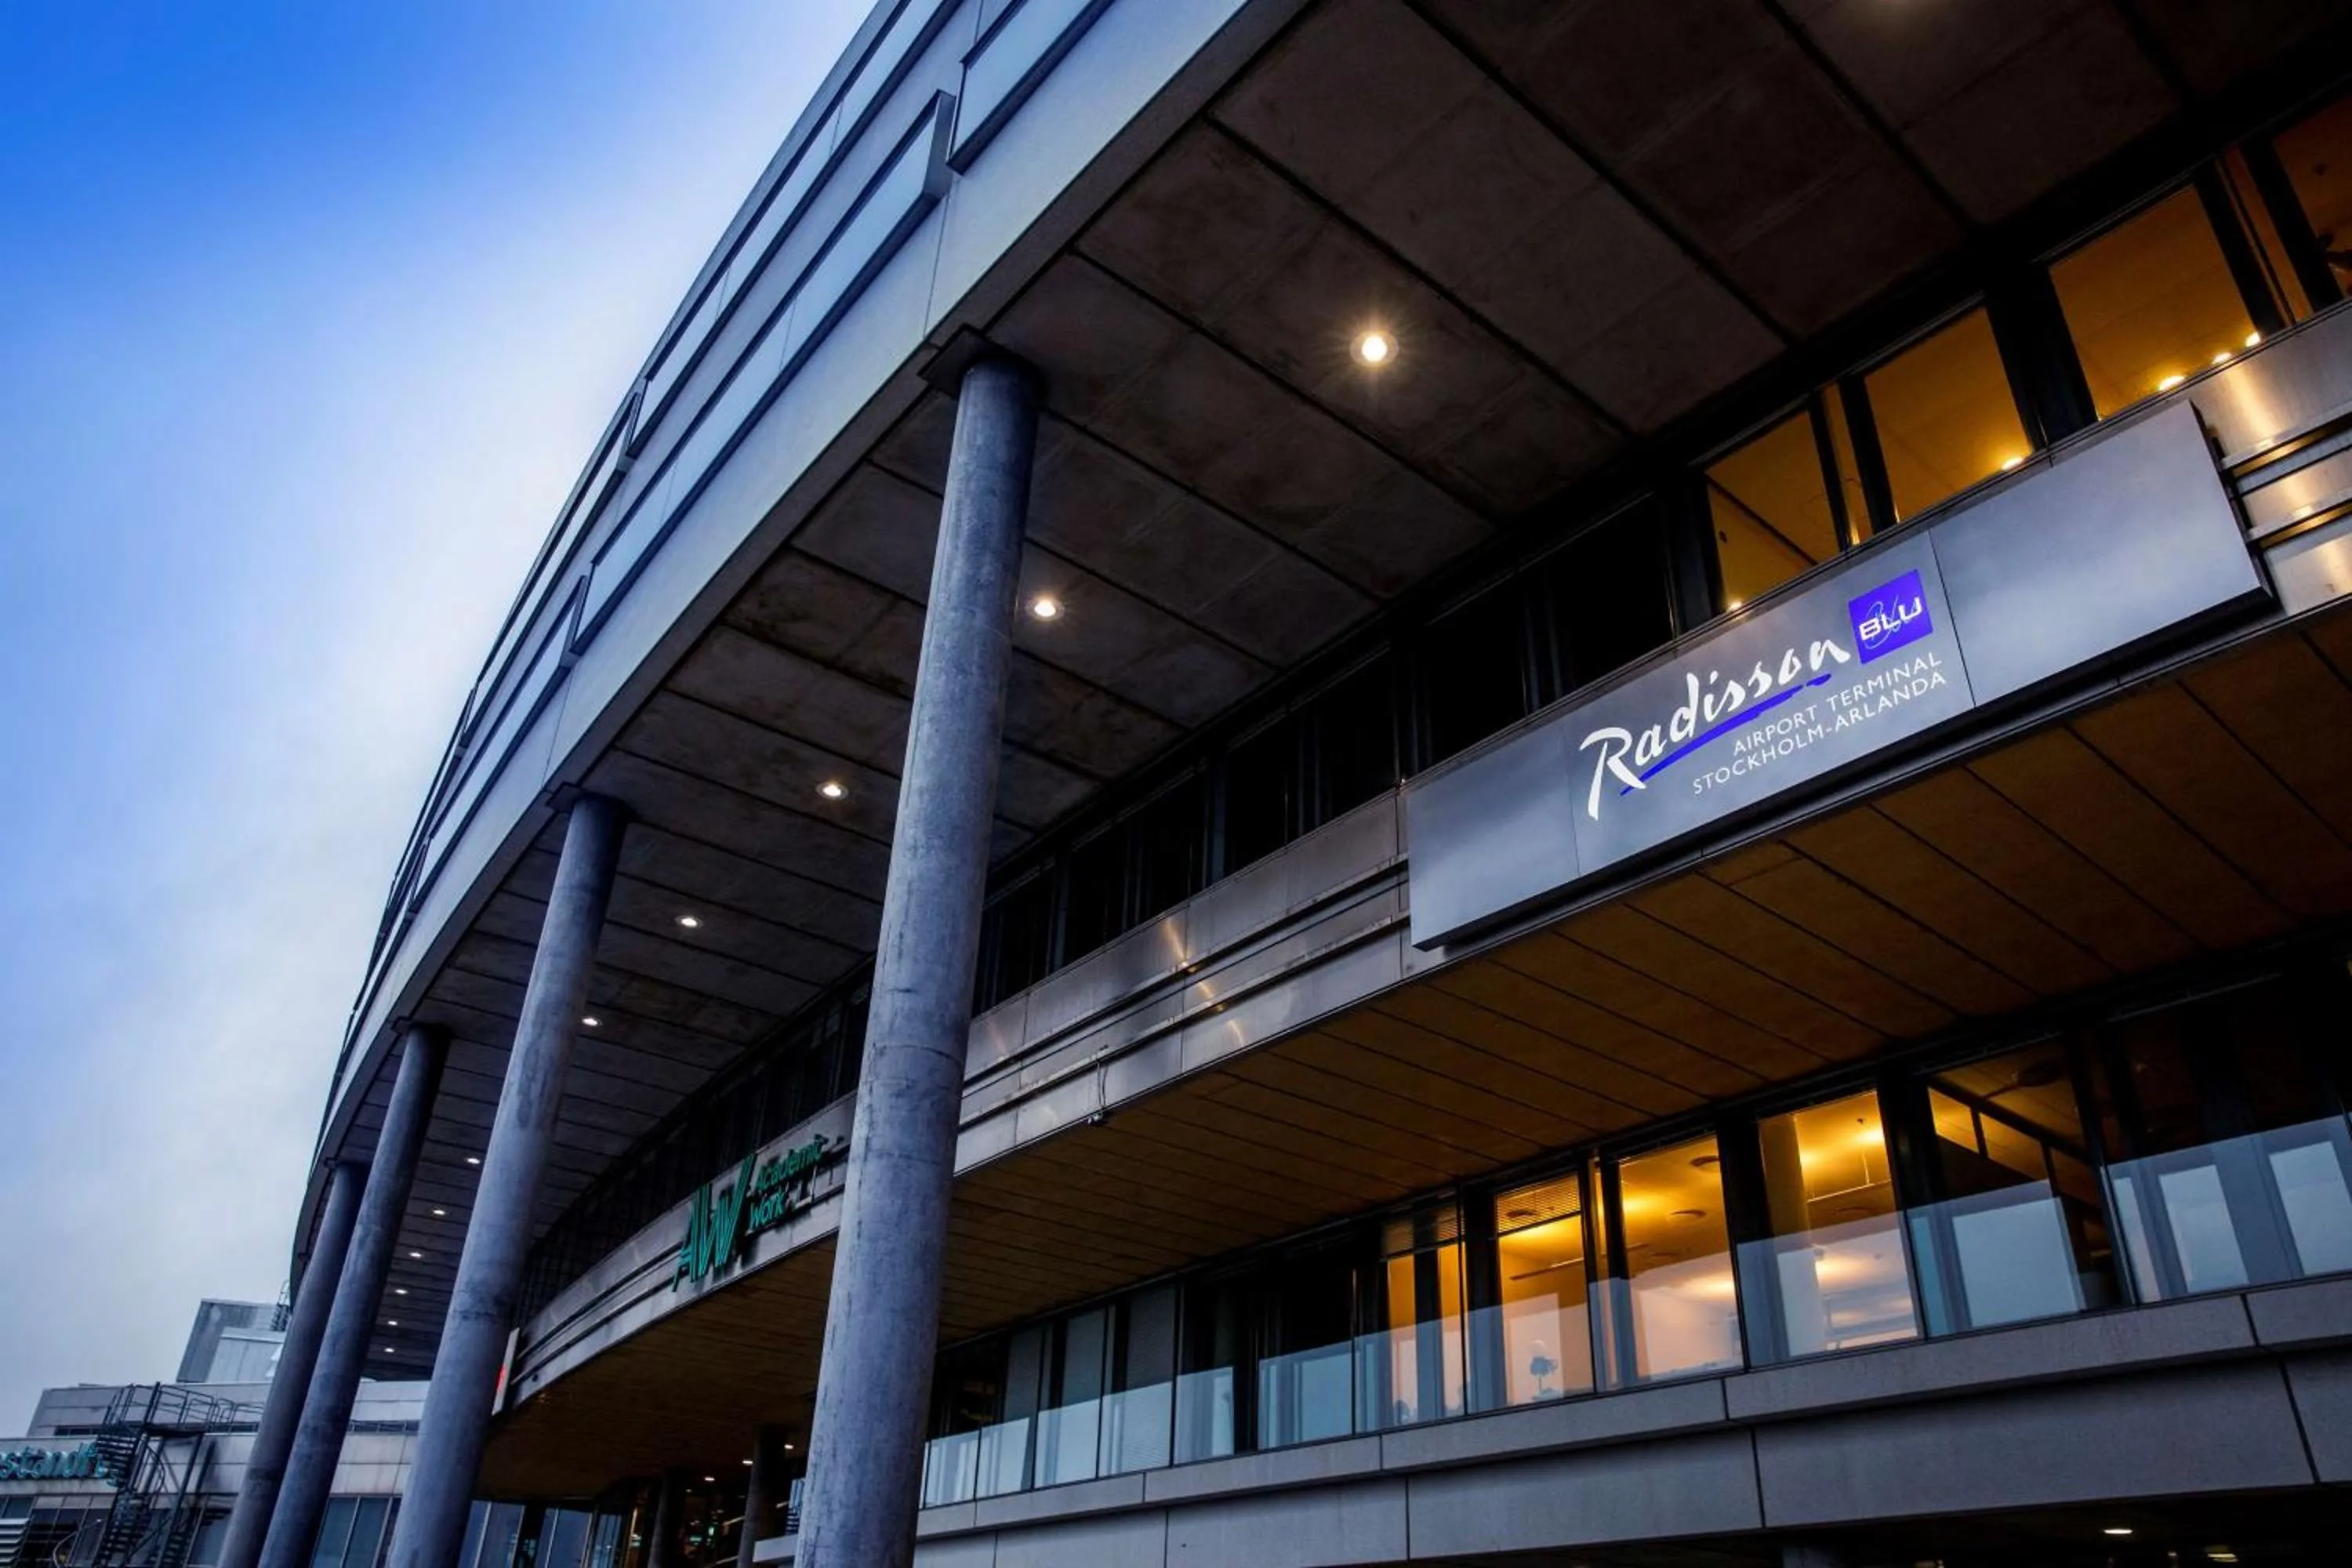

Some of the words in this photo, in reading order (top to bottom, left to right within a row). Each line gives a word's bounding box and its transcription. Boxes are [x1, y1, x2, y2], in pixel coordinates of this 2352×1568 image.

[1858, 596, 1923, 641] BLU
[1579, 638, 1851, 821] Radisson
[1693, 671, 1947, 795] STOCKHOLM-ARLANDA
[1732, 705, 1818, 756] AIRPORT
[1826, 652, 1943, 711] TERMINAL
